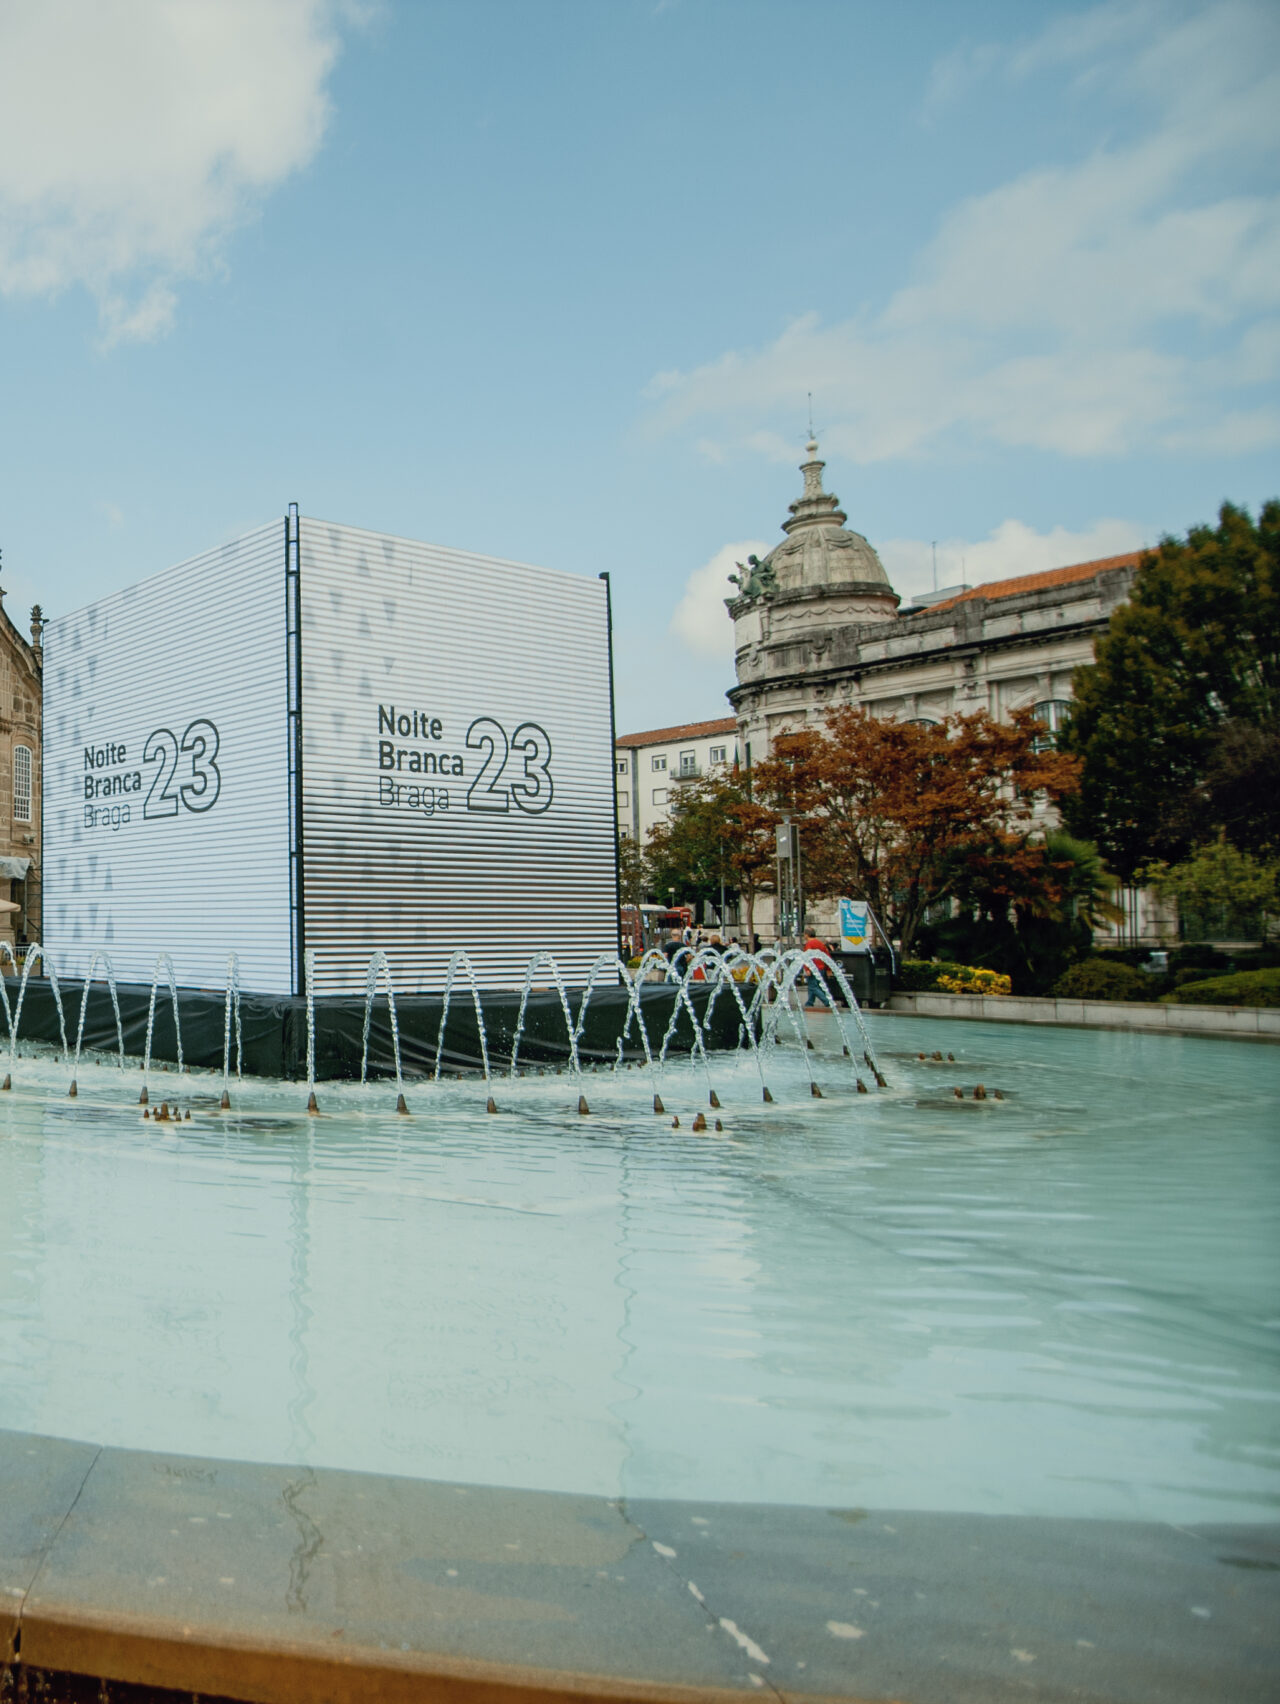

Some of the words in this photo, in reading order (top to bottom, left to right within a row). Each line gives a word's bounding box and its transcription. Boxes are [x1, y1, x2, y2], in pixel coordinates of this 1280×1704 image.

[378, 704, 443, 740] Noite
[84, 742, 127, 771] Noite
[143, 718, 221, 820] 23
[378, 740, 464, 776] Branca
[465, 717, 554, 815] 23
[84, 771, 142, 800] Branca
[379, 776, 450, 816] Braga
[84, 803, 131, 831] Braga
